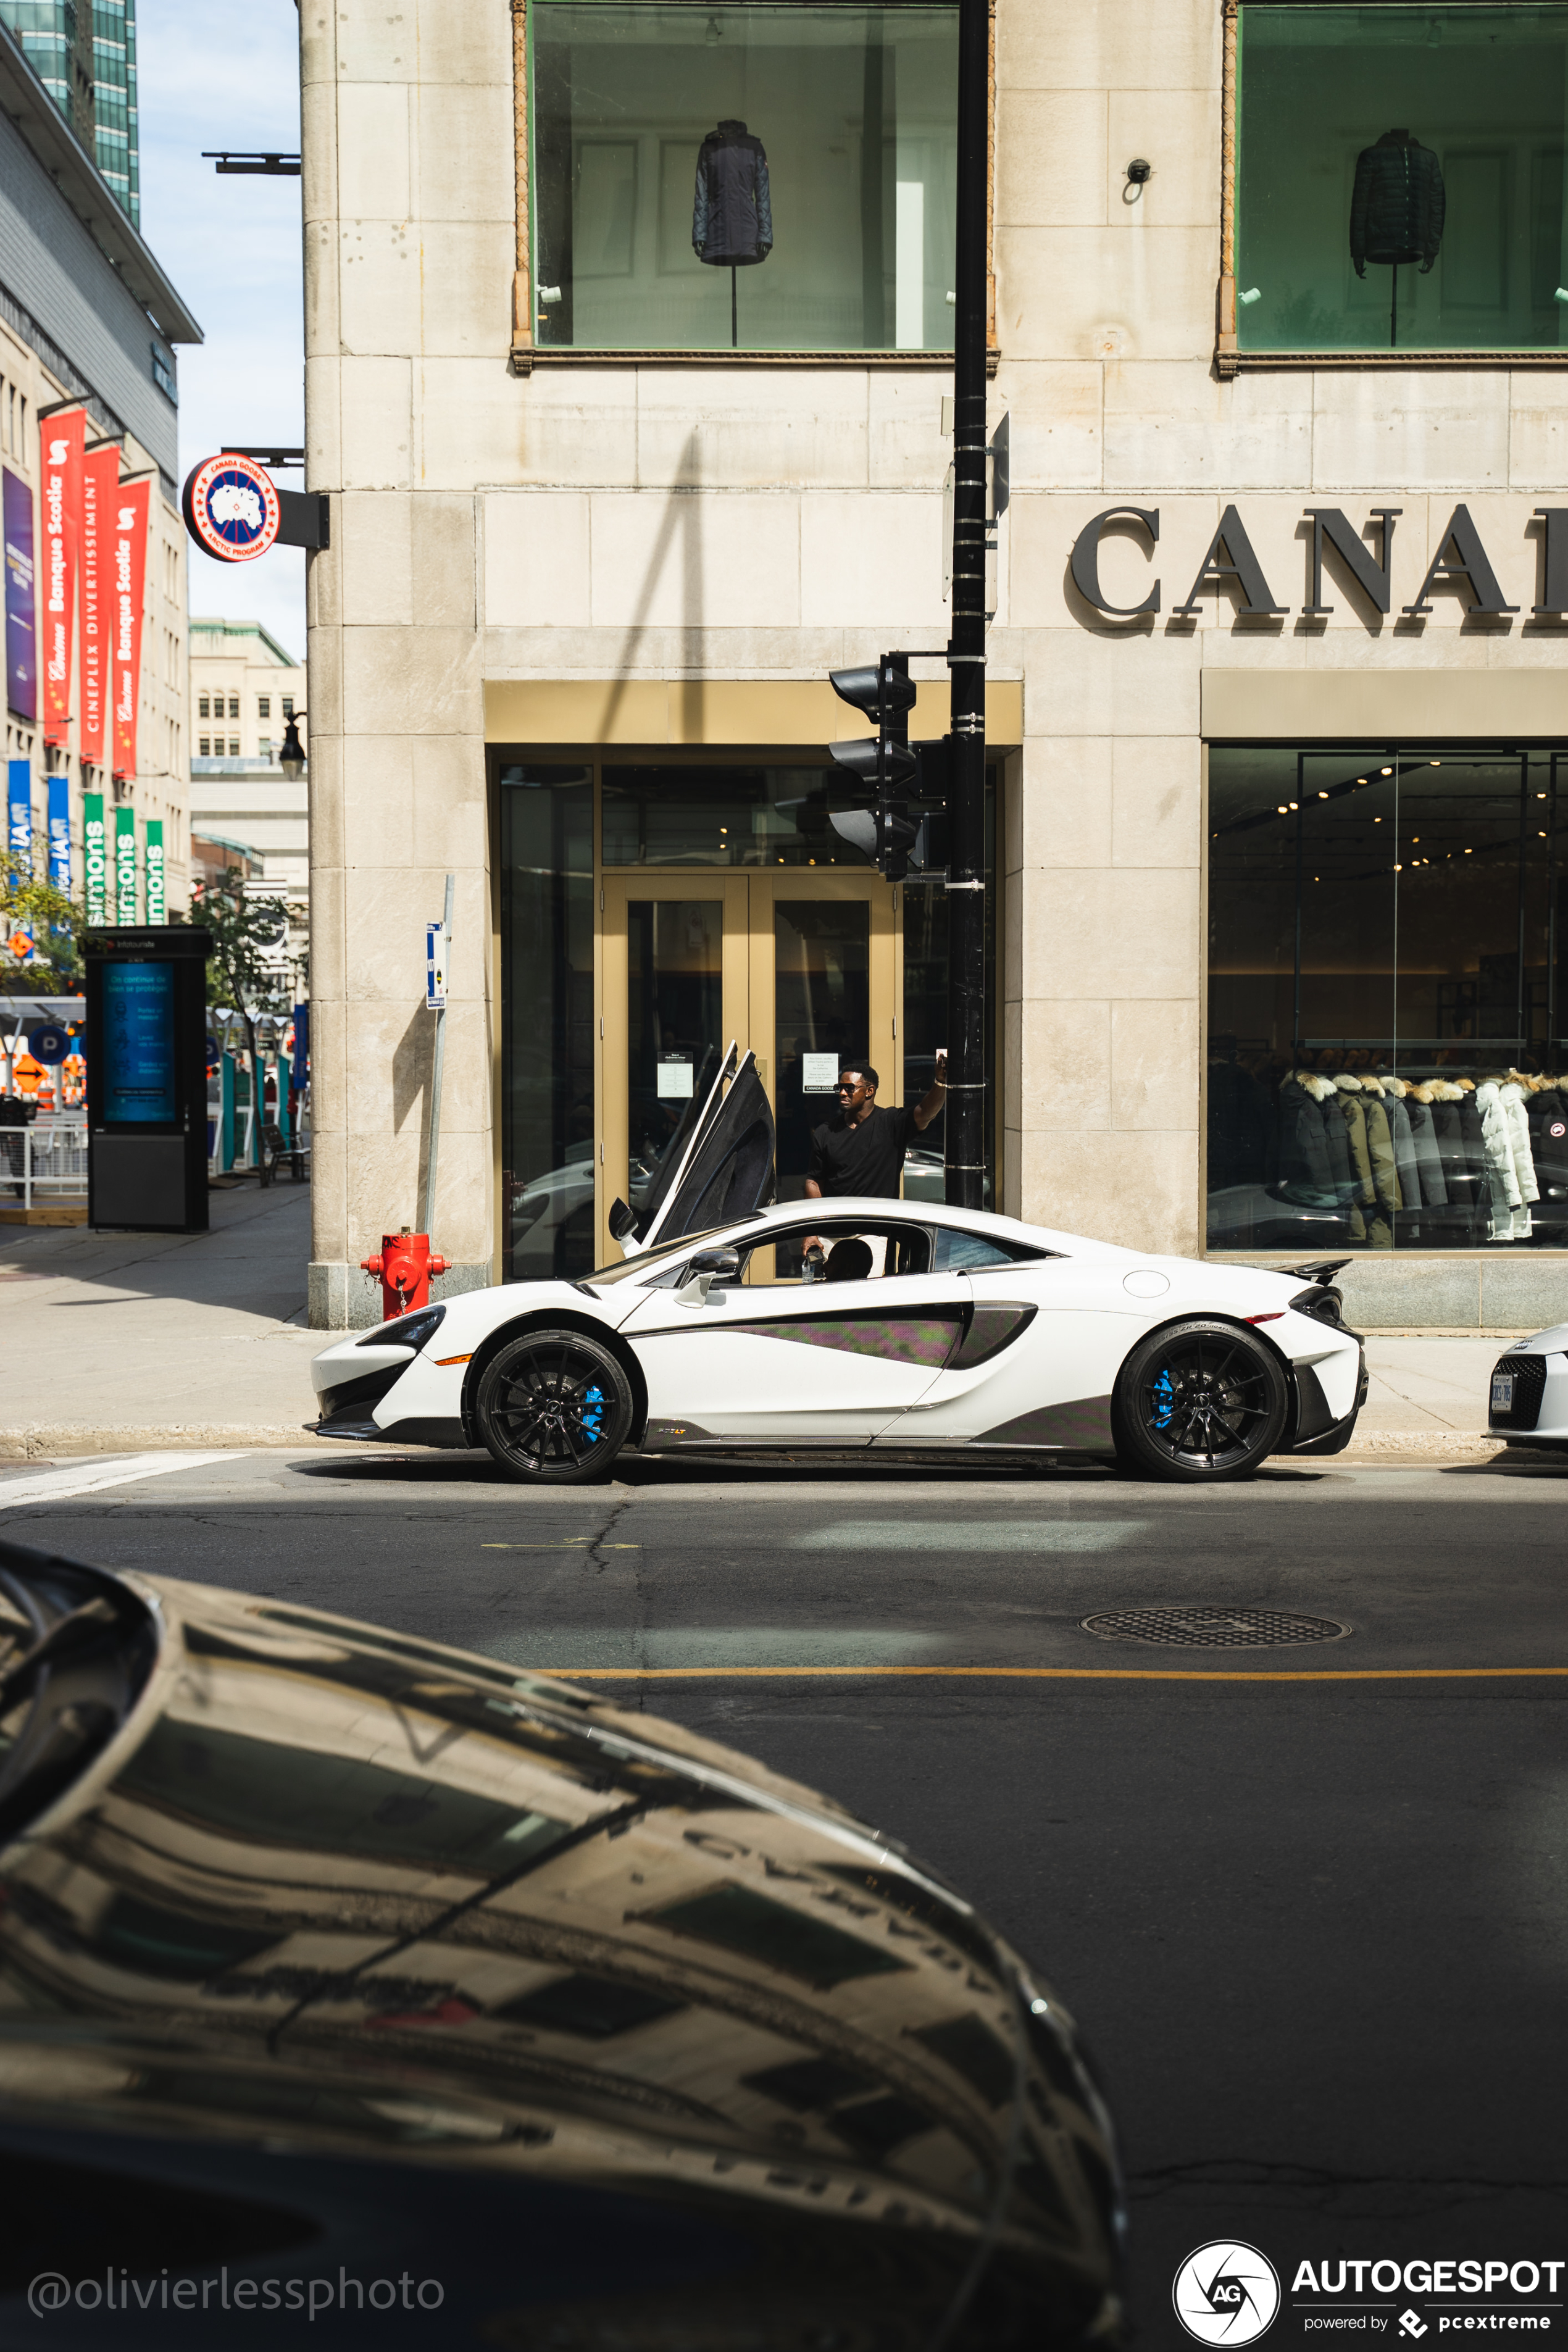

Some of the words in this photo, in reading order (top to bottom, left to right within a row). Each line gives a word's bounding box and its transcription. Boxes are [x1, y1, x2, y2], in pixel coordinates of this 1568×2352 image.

[211, 460, 237, 473] CANADA
[46, 473, 62, 535] Scotia
[49, 538, 67, 612] Banque
[84, 475, 98, 635] DIVERTISSEMENT
[115, 538, 131, 593] Scotia
[207, 533, 231, 553] ARCTIC
[232, 541, 264, 556] PROGRAM
[1070, 504, 1568, 615] CANA
[117, 594, 135, 661] Banque
[86, 644, 99, 733] CINEPLEX
[86, 820, 105, 927] simons
[147, 845, 164, 925] imons
[123, 975, 154, 983] continue
[43, 1036, 57, 1051] P
